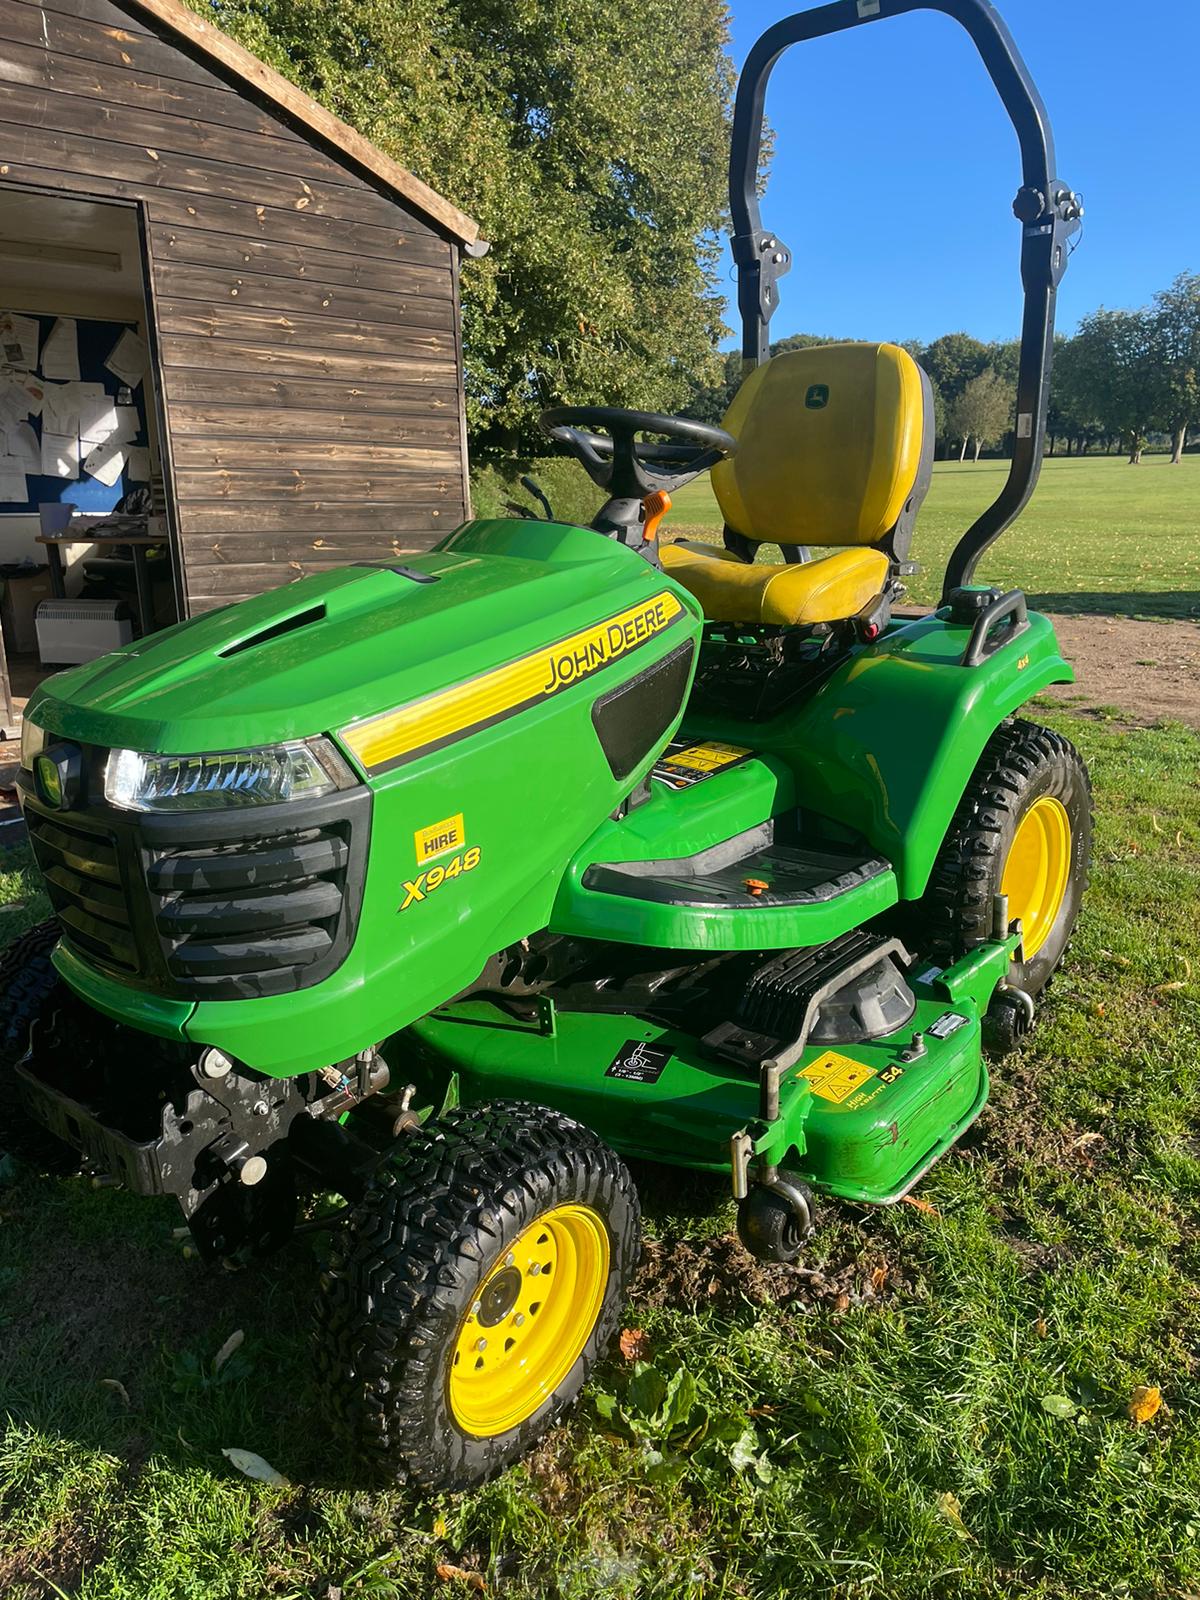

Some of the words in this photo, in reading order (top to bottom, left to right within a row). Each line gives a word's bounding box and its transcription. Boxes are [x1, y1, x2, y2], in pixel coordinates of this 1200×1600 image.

[544, 637, 604, 690] JOHN
[608, 603, 667, 651] DEERE
[424, 829, 458, 854] HIRE
[398, 846, 481, 912] X948
[880, 1066, 903, 1083] 54
[847, 1092, 867, 1108] HIGH
[853, 1084, 886, 1110] CAPACITY
